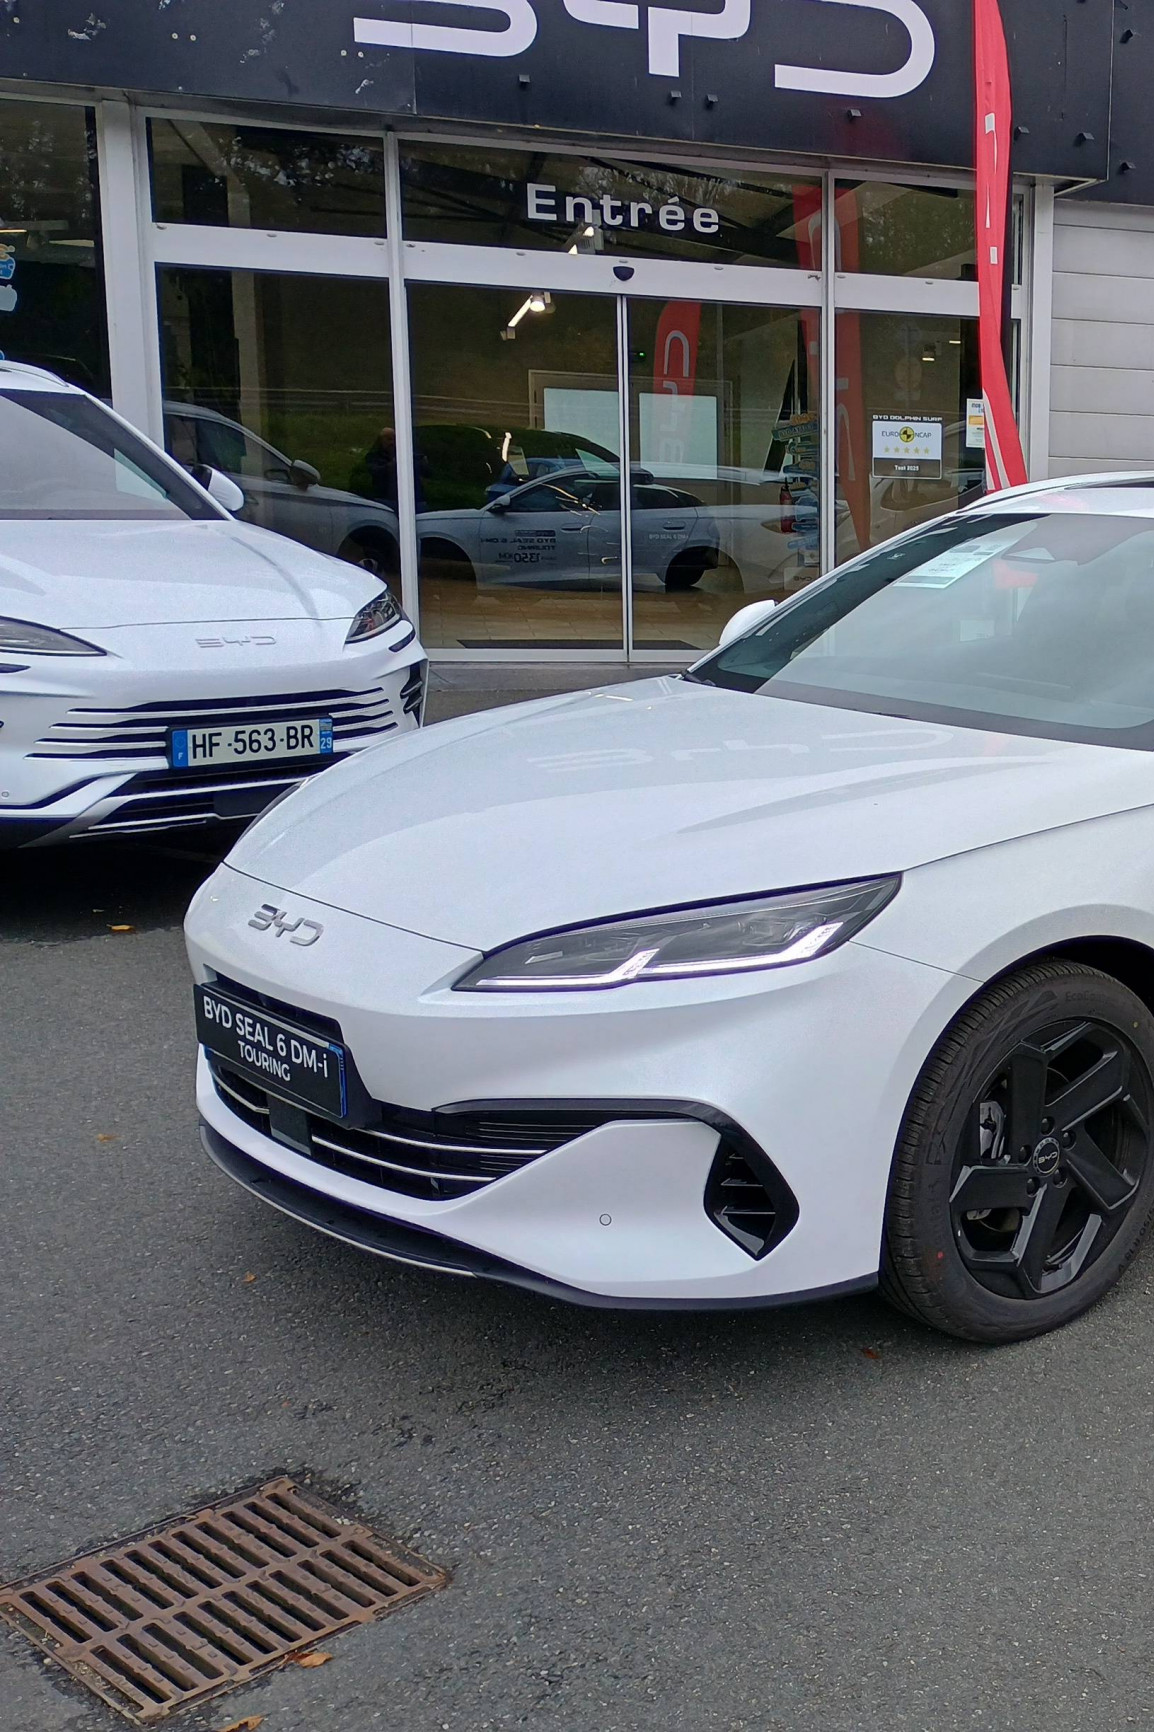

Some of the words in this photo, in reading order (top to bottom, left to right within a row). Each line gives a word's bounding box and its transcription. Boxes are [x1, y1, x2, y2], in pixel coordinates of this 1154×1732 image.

[526, 183, 720, 235] Entrée
[881, 430, 899, 438] EURO
[914, 431, 932, 439] NCAP
[195, 636, 277, 648] BYD
[177, 752, 184, 761] F
[191, 724, 314, 759] HF-563-BR
[320, 737, 332, 749] 29
[247, 903, 324, 947] BYD
[203, 995, 232, 1029] BYD
[235, 1012, 274, 1051] SEAL
[276, 1032, 286, 1056] 6
[290, 1039, 328, 1078] DM-i
[237, 1040, 291, 1082] TOURING
[1038, 1151, 1058, 1164] BYD
